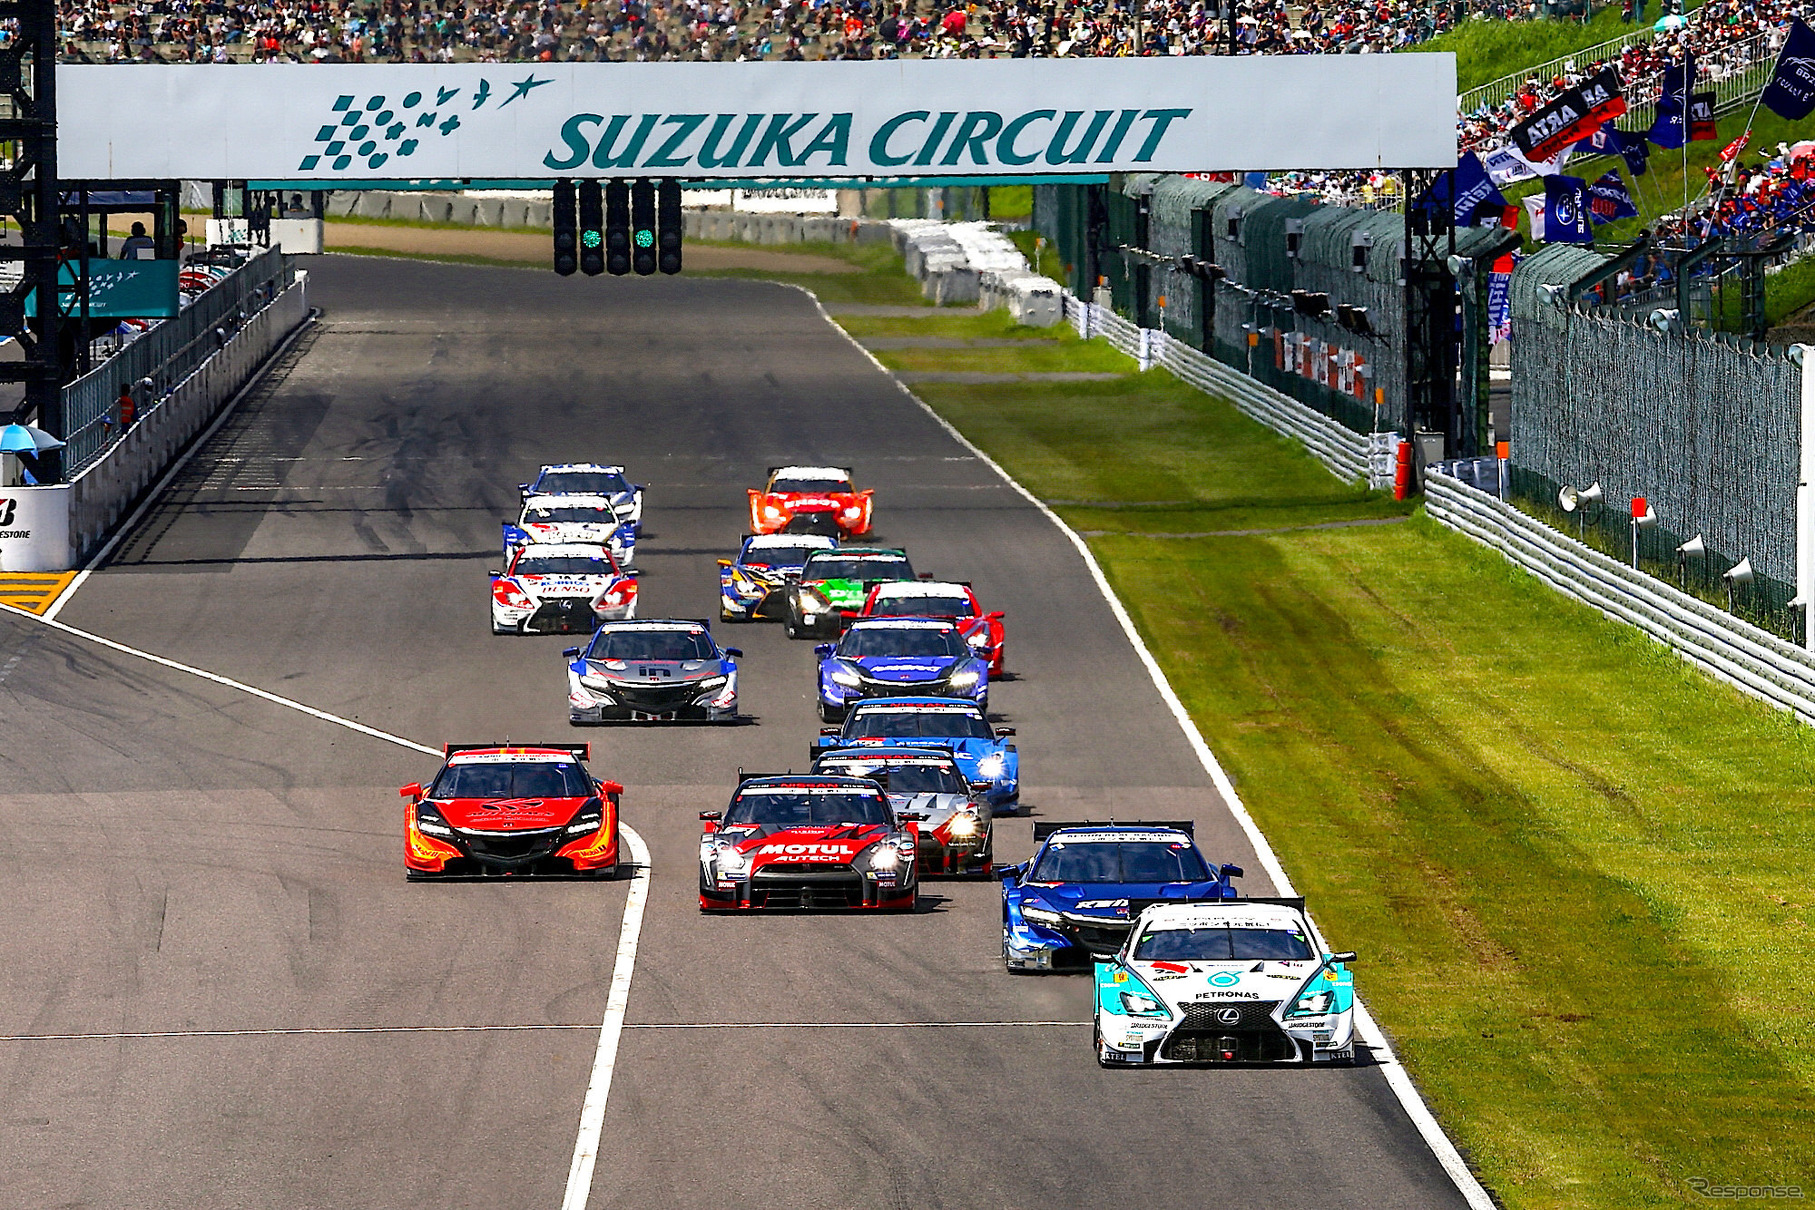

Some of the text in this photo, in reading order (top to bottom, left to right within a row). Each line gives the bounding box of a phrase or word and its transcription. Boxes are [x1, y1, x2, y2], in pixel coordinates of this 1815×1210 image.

[543, 109, 1192, 170] SUZUKA CIRCUIT
[0, 530, 31, 539] ESTONE
[758, 844, 854, 855] MOTUL
[1195, 990, 1260, 1000] PETRONAS
